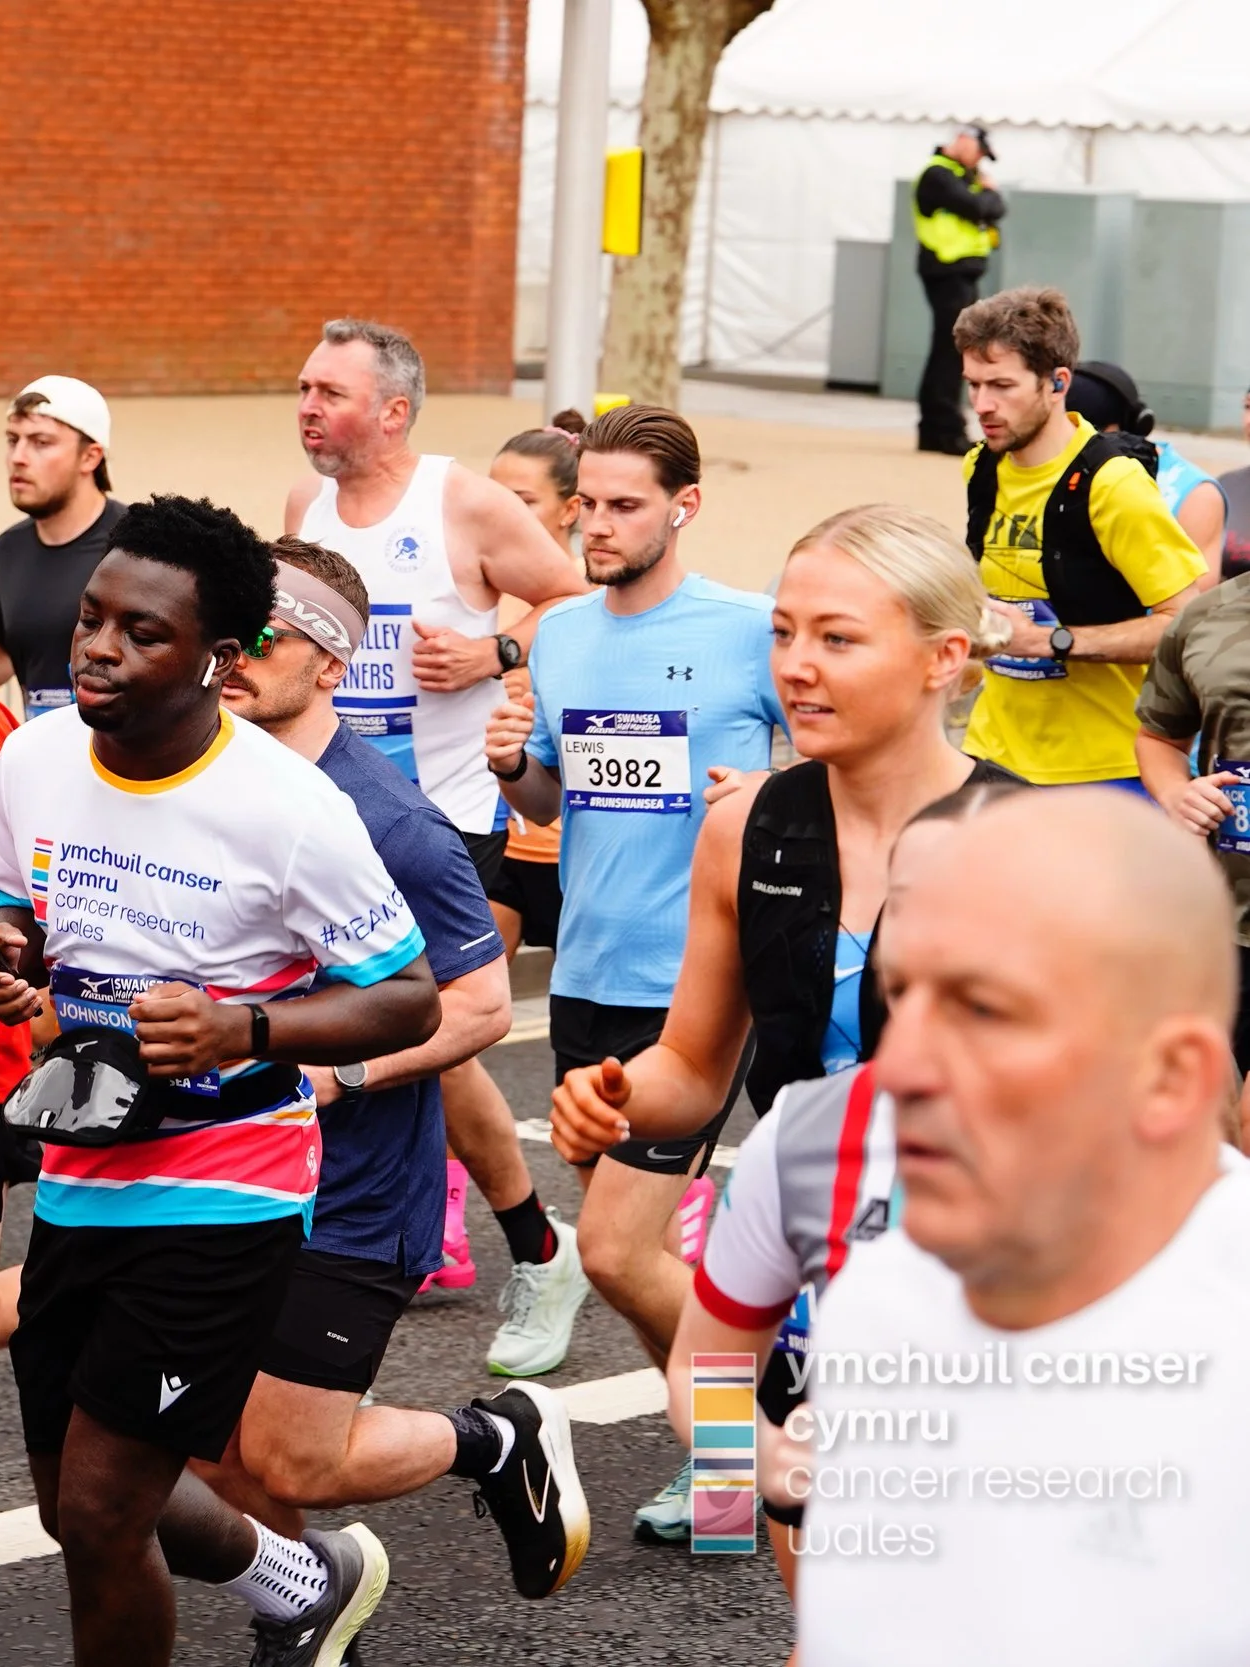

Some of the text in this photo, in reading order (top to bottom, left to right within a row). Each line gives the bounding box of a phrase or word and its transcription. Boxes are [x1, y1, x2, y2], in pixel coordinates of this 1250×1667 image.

[361, 623, 401, 649] LLEY
[617, 713, 660, 723] SWANSEA
[565, 741, 604, 754] LEWIS
[588, 758, 661, 787] 3982
[589, 796, 665, 809] #RUNSWANSEA
[60, 843, 222, 892] ymchwil canser
[57, 868, 118, 892] cymru
[752, 880, 803, 897] SALOMON
[55, 892, 205, 940] cancer research
[56, 918, 104, 941] wales
[59, 1002, 132, 1029] JOHNSON
[327, 1331, 349, 1343] KIPRUN
